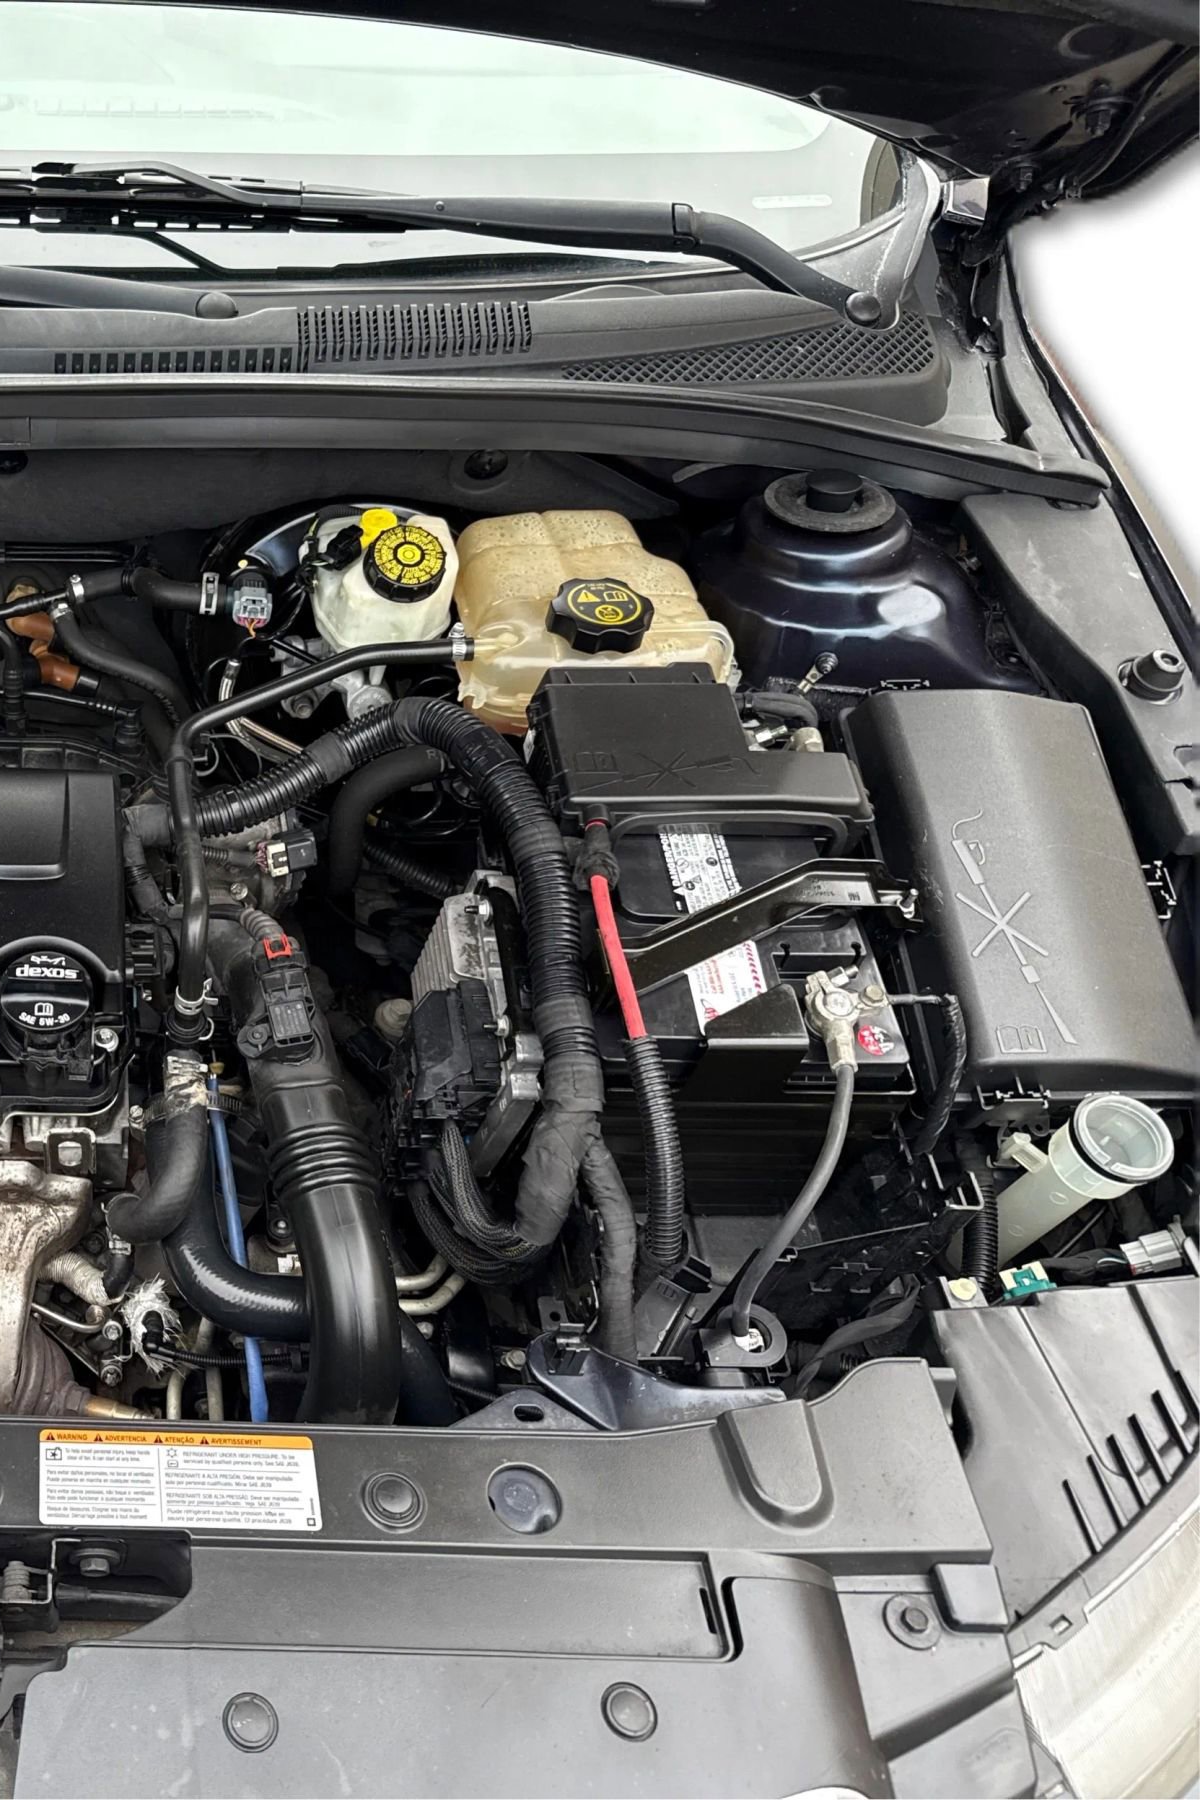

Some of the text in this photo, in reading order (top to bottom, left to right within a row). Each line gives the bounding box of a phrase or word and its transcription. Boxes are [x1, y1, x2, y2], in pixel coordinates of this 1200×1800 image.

[15, 964, 79, 979] dexos
[19, 1012, 70, 1026] SAE 5W-30
[164, 1436, 195, 1444] ATENÇÃO
[211, 1438, 262, 1446] AVERTISSEMENT
